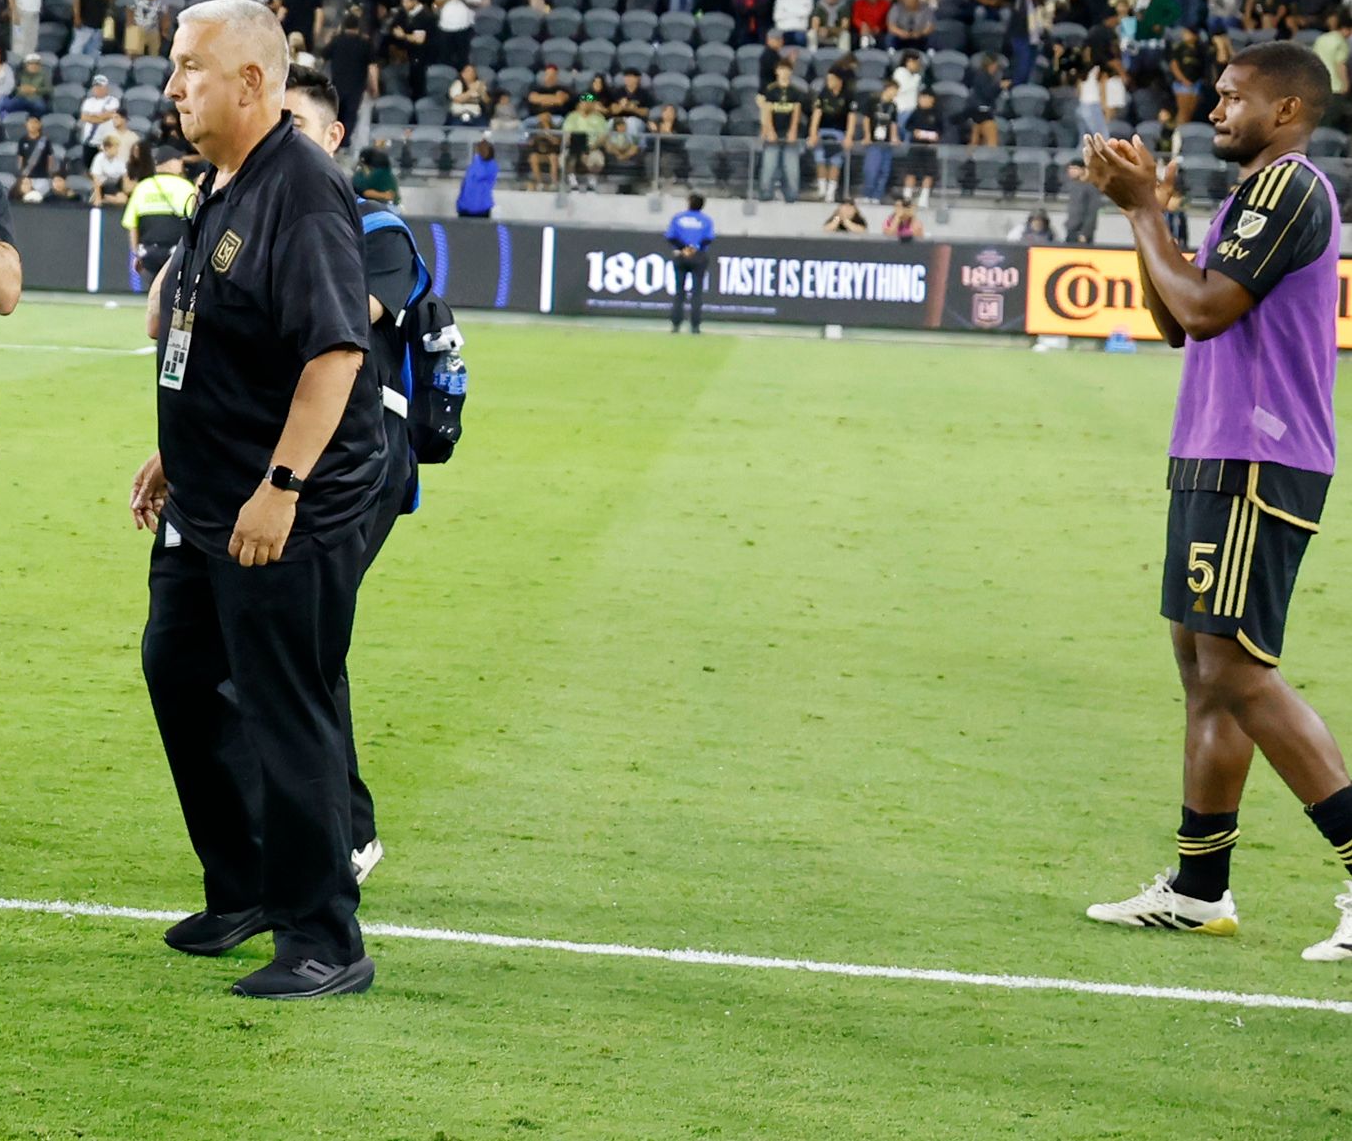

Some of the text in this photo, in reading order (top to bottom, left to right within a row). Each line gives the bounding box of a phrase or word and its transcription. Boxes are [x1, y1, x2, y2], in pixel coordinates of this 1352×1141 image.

[717, 256, 777, 297] TASTE
[778, 258, 800, 298] IS
[801, 260, 926, 304] EVERYTHING
[961, 265, 1019, 288] 1800
[1045, 261, 1137, 321] Con
[1187, 541, 1218, 594] 5
